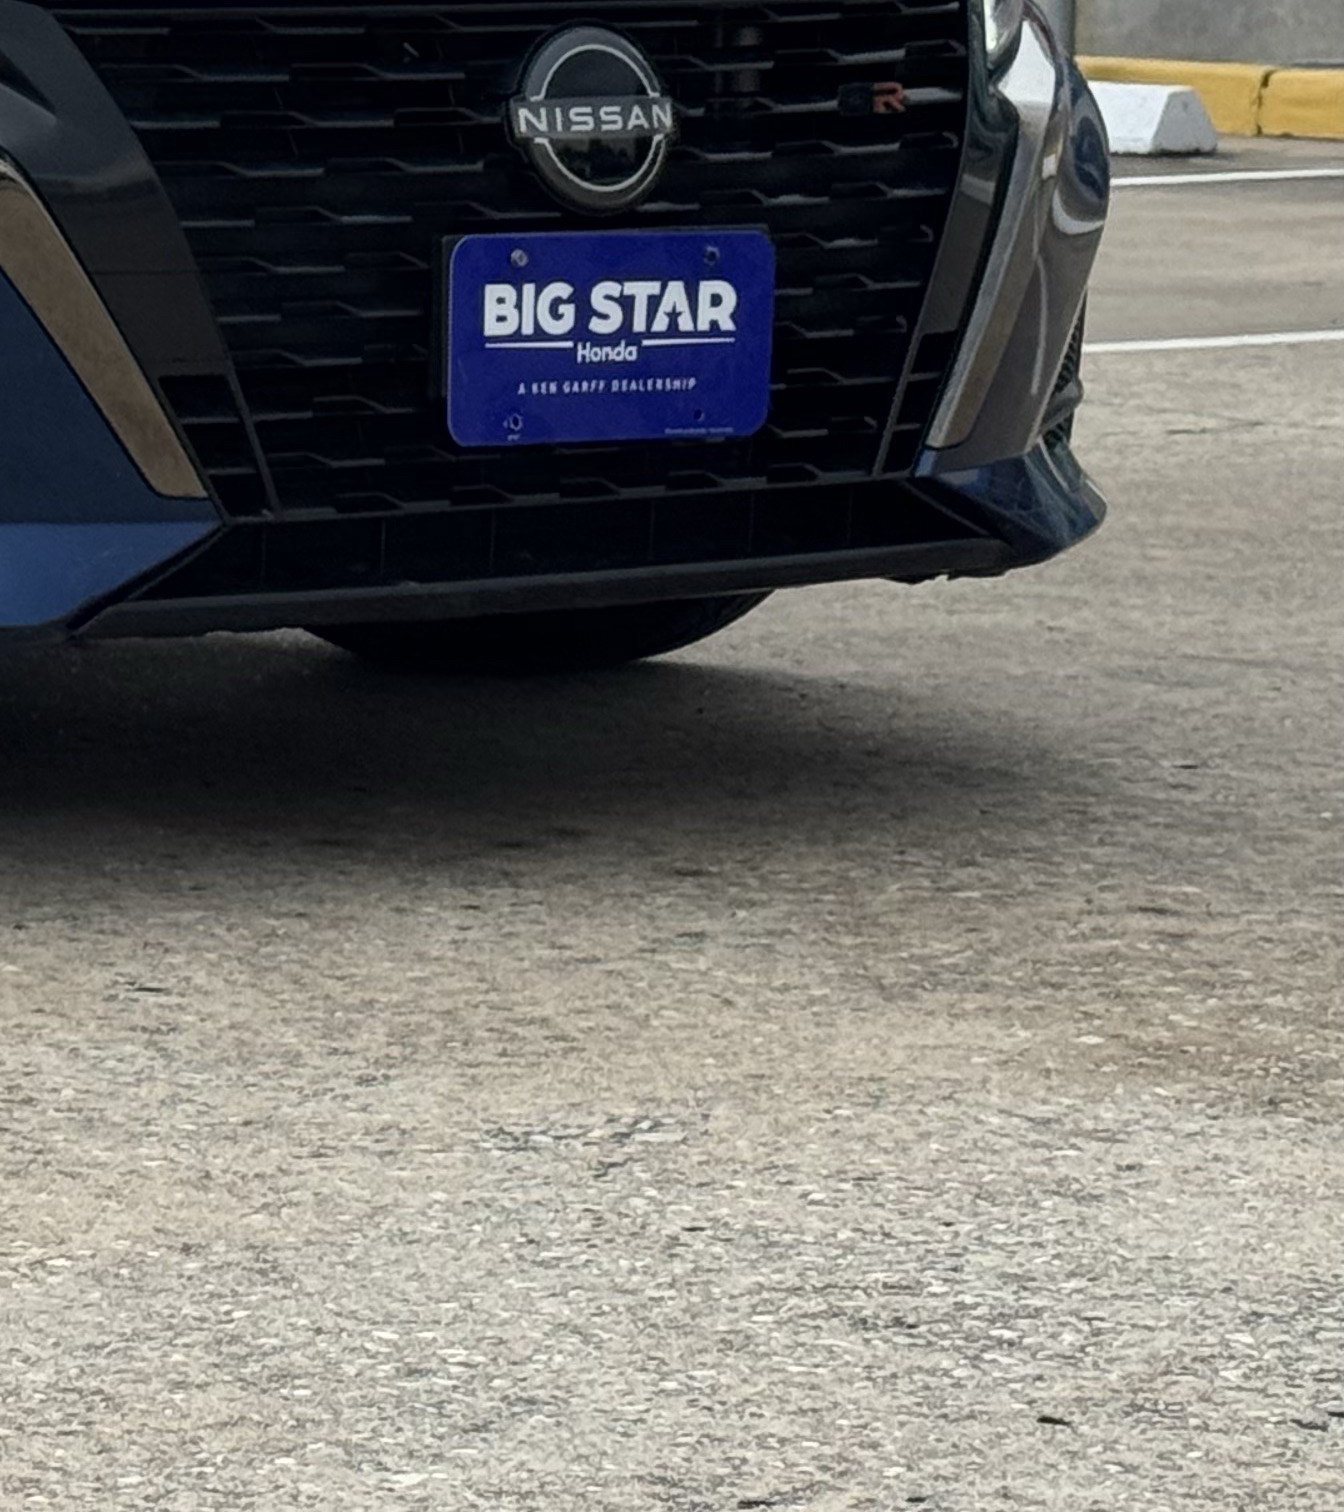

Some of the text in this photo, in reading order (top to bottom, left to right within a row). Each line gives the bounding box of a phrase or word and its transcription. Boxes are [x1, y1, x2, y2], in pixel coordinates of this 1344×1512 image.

[518, 104, 673, 134] NISSAN
[483, 280, 737, 336] BIG STAR
[576, 340, 638, 363] Honda
[517, 382, 526, 395] A
[611, 376, 697, 393] DEALERSHIP
